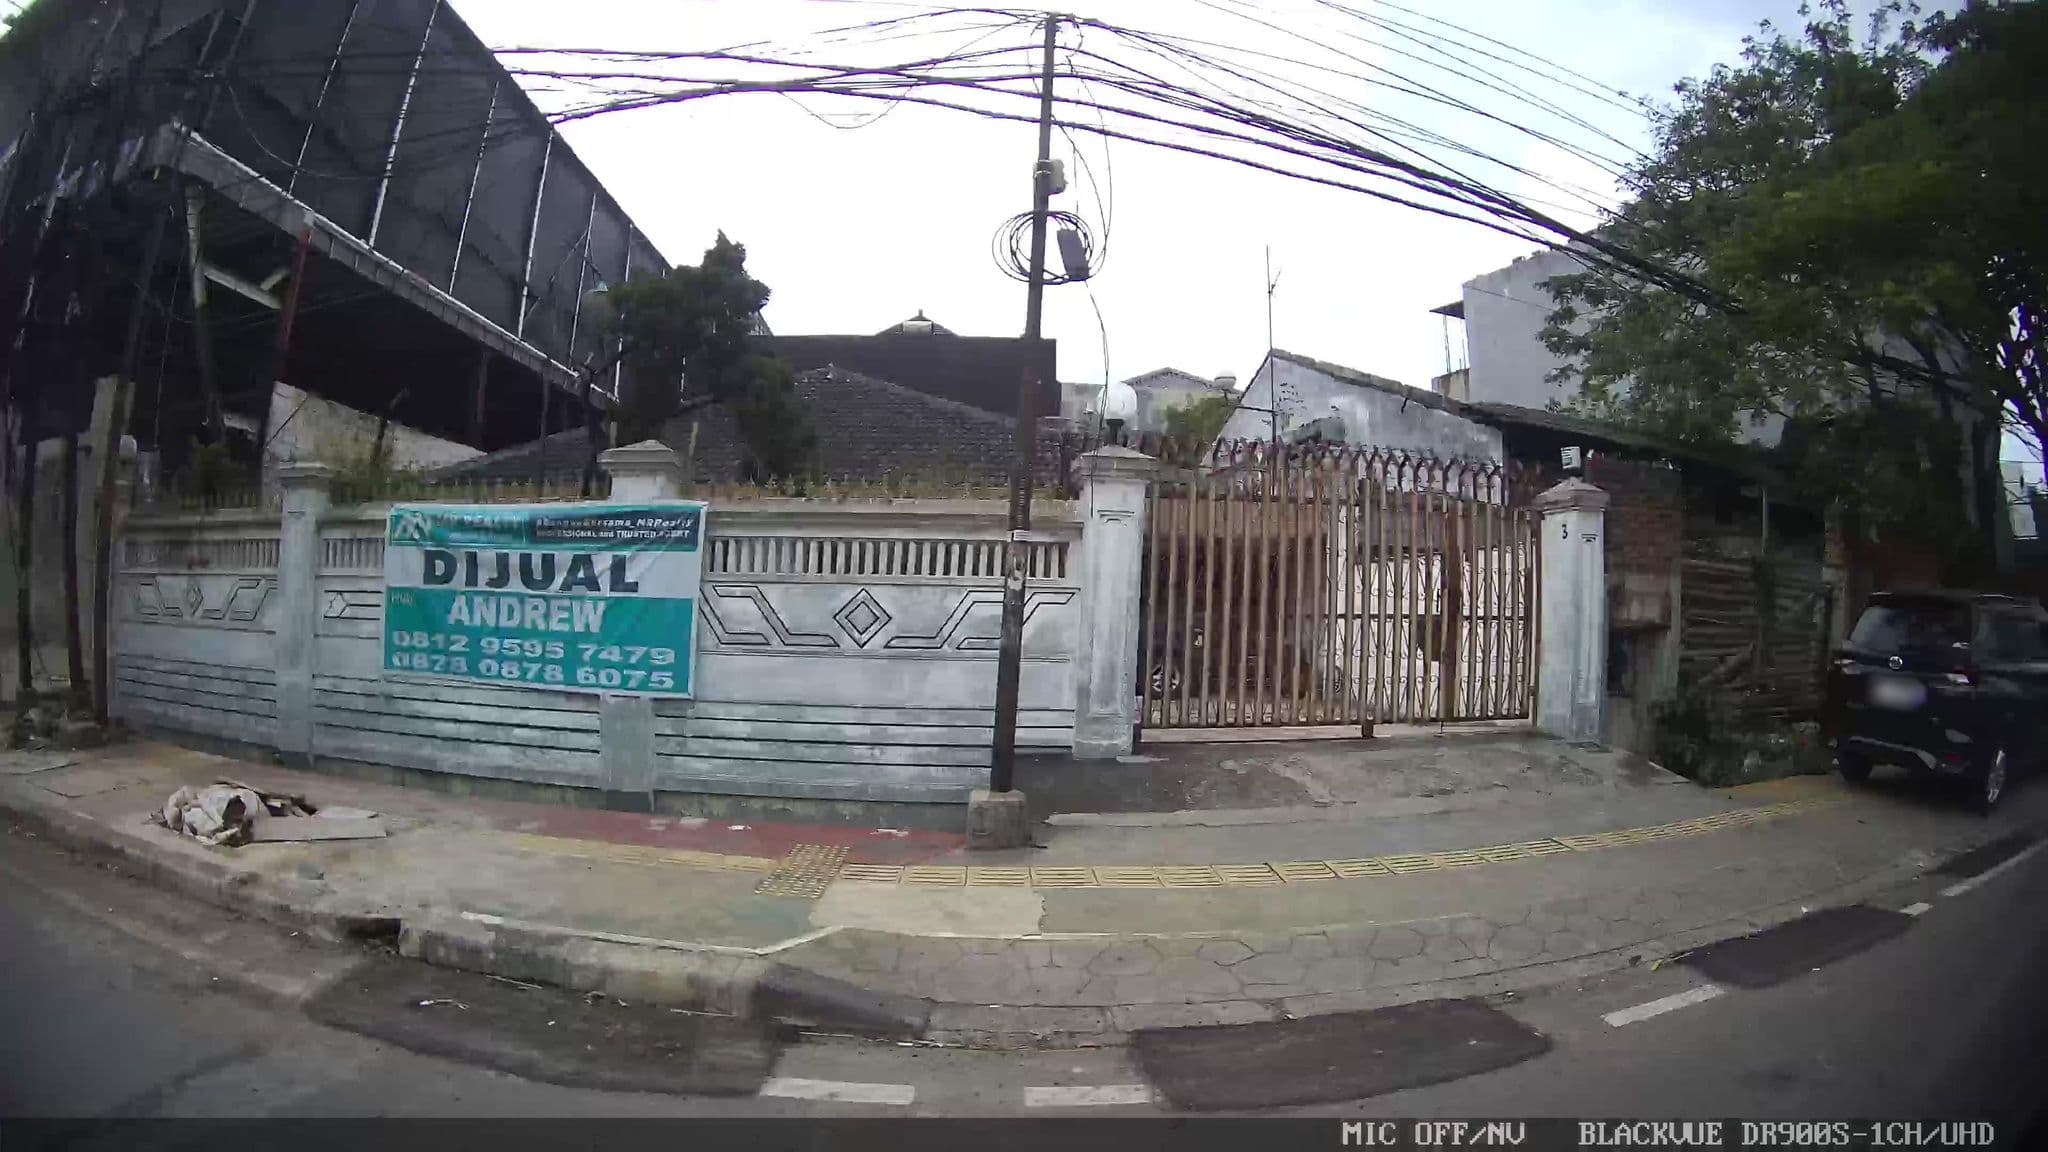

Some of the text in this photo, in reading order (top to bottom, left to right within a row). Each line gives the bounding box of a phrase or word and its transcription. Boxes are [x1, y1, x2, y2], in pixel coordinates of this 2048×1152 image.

[536, 529, 597, 538] ESSIONAL
[616, 530, 656, 538] TRUSTED
[1562, 524, 1568, 539] 3
[422, 549, 639, 593] DIJUAL
[448, 594, 607, 633] ANDREW
[392, 630, 675, 665] 0812 9595 7479
[478, 659, 564, 682] 0878
[576, 667, 674, 689] 6075
